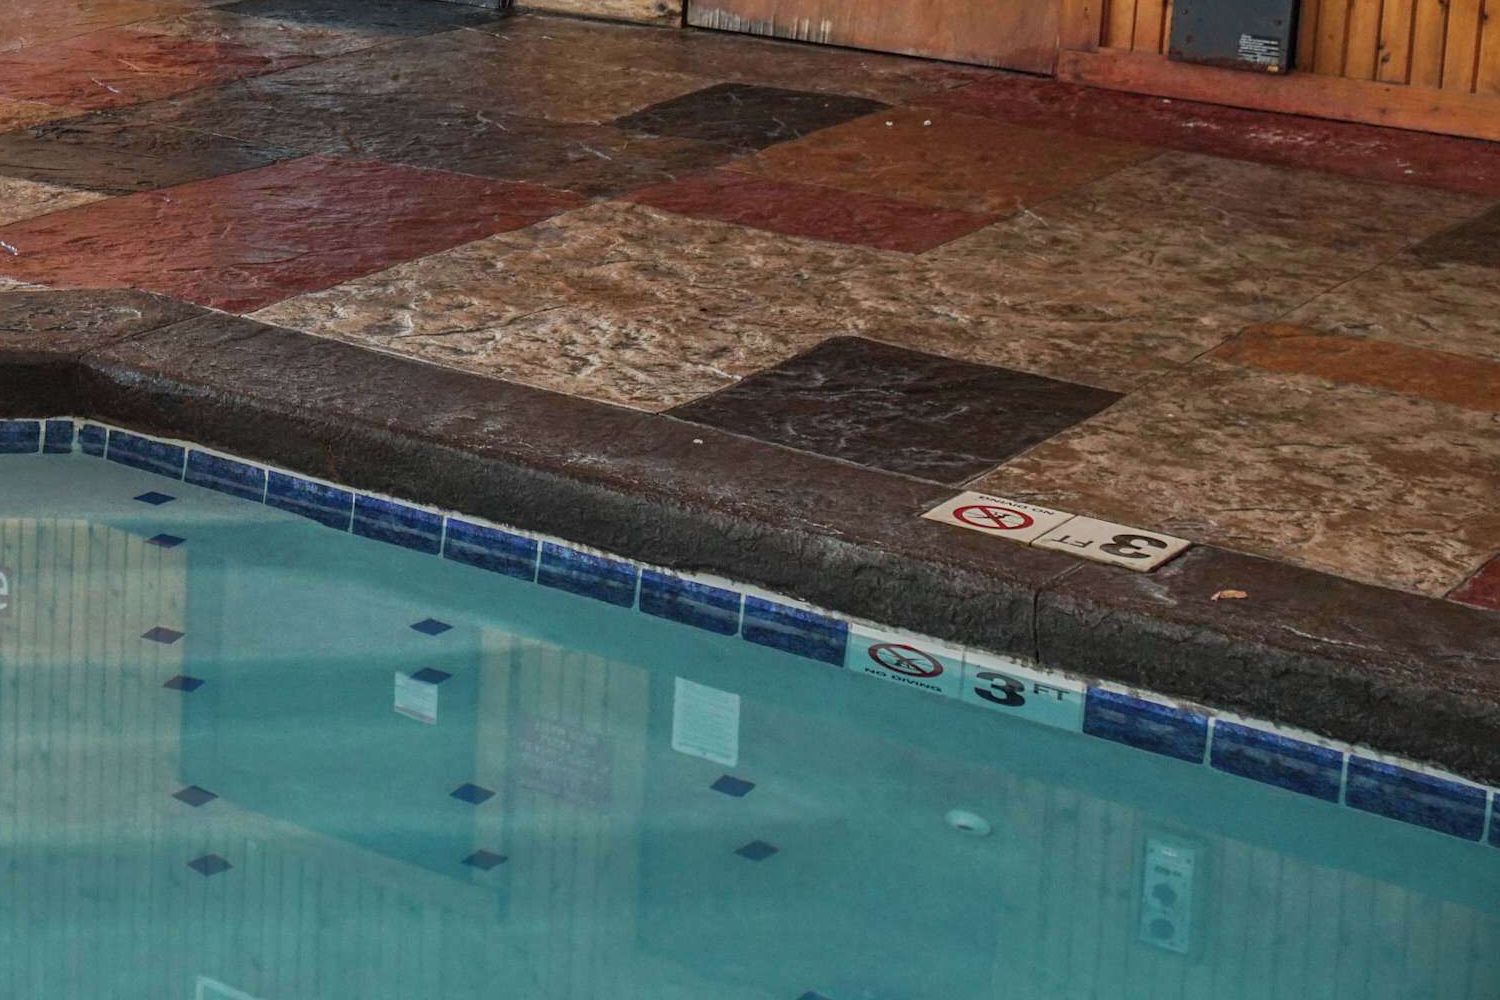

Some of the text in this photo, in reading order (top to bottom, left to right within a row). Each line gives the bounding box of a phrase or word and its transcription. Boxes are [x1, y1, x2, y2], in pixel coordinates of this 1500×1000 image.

[1031, 507, 1055, 516] NO
[1051, 533, 1168, 560] 3 FT
[864, 667, 943, 693] NO DIVING
[974, 671, 1070, 708] 3 FT
